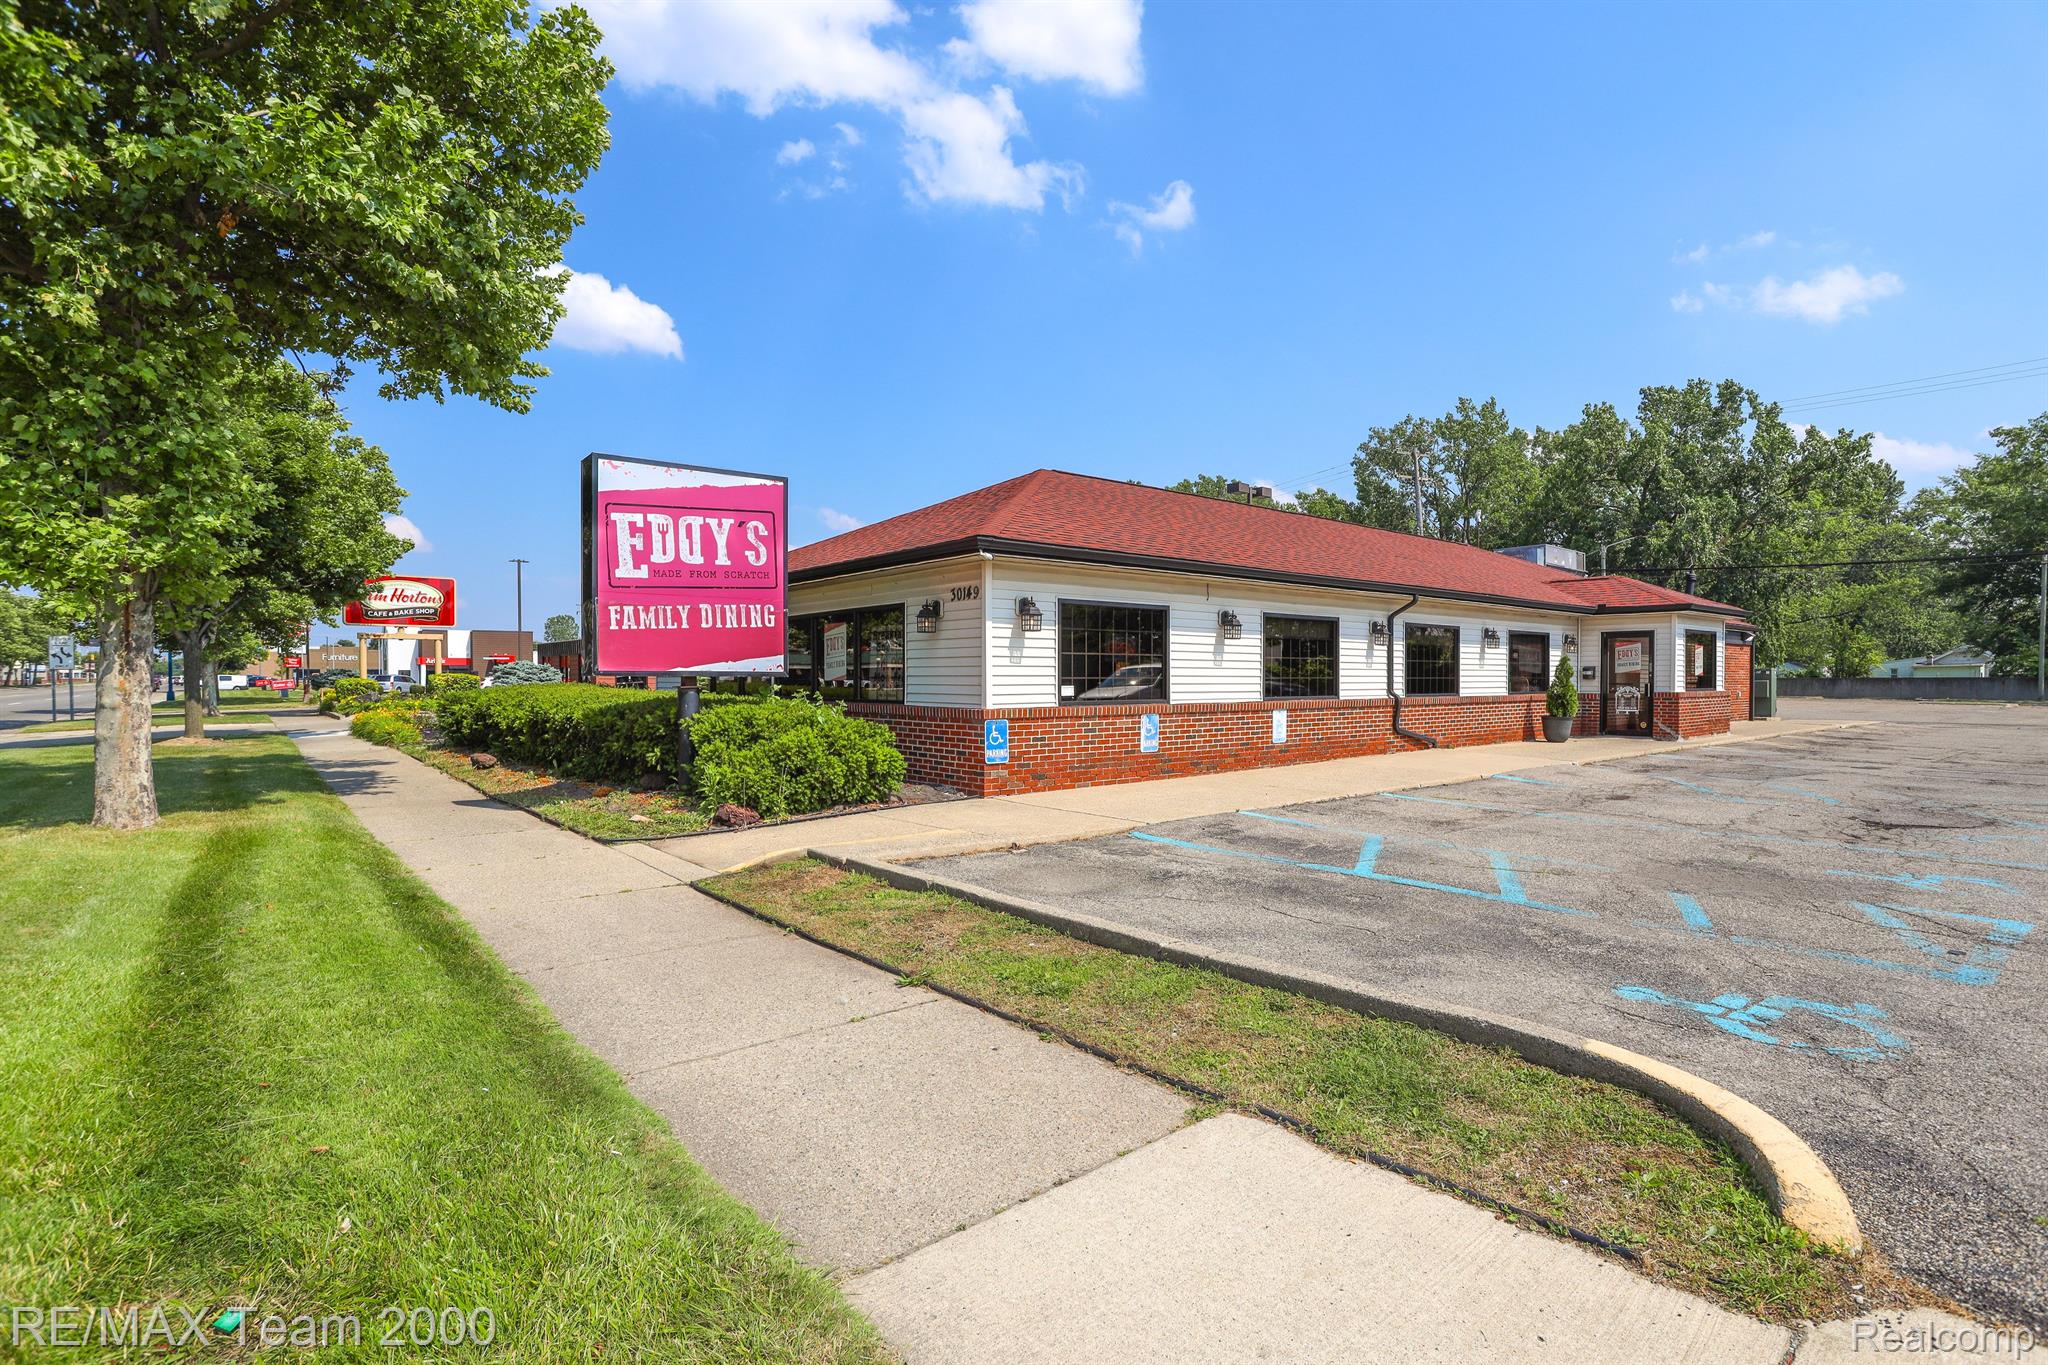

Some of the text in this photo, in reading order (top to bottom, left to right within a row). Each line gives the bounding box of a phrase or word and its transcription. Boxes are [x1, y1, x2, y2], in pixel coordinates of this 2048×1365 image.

[610, 512, 769, 579] EDDY'S
[653, 570, 770, 579] MADE FROM SCRATCH
[389, 587, 443, 604] Hortons
[950, 585, 980, 602] 30149
[608, 604, 776, 630] FAMILY DINING
